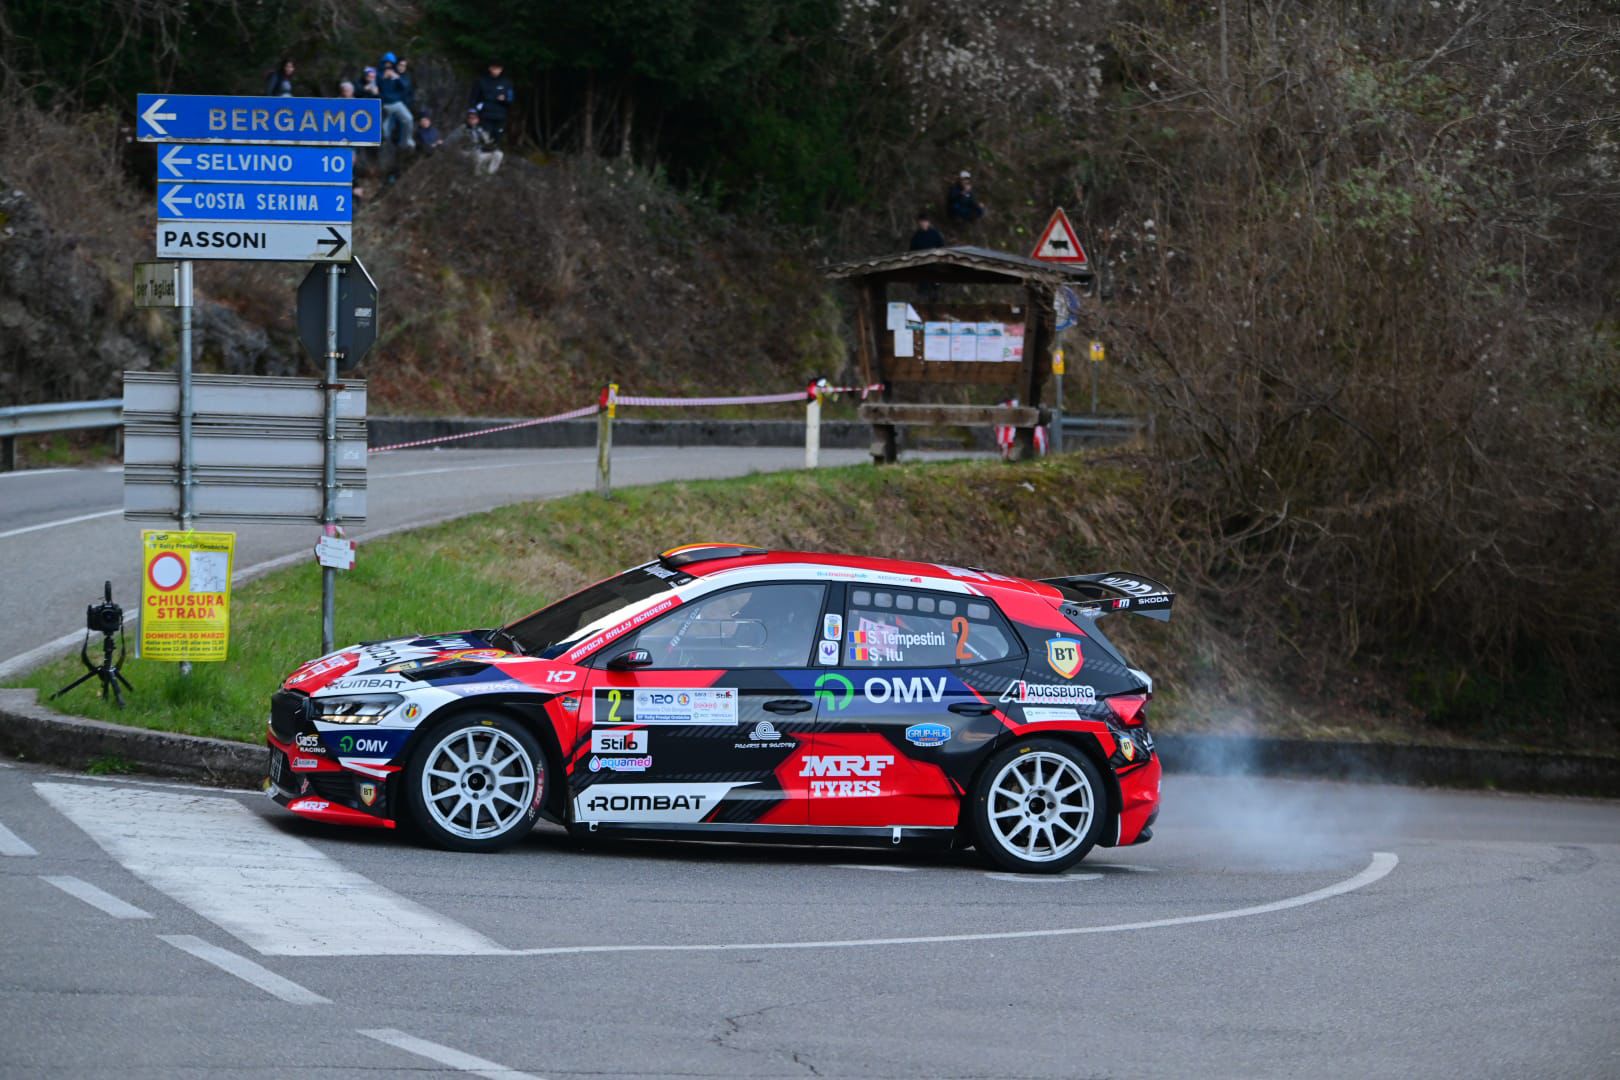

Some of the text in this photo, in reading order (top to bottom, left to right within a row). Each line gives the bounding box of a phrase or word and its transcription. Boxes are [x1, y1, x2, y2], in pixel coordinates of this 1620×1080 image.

[208, 108, 373, 133] BERGAMO
[196, 153, 345, 173] SELVINO 10
[195, 192, 345, 212] COSTA SERINA 2
[164, 230, 267, 249] PASSONI
[147, 594, 224, 607] CHIUSURA
[157, 607, 216, 619] STRADA
[570, 599, 673, 661] NAPOCA RALLY ACADEMY
[951, 616, 973, 660] 2
[868, 630, 945, 648] S. Tempestini
[869, 647, 904, 661] S. Itu
[1054, 647, 1076, 661] BT
[864, 676, 947, 704] OMV
[1027, 685, 1094, 698] AUGSBURG
[608, 689, 622, 721] 2
[650, 694, 674, 705] 120
[356, 739, 388, 753] OMV
[600, 732, 638, 750] Stilo
[600, 755, 652, 769] aquamed
[799, 755, 894, 777] MRF
[363, 788, 373, 796] BT
[811, 780, 881, 797] TYRES
[588, 795, 706, 811] ROMBAT
